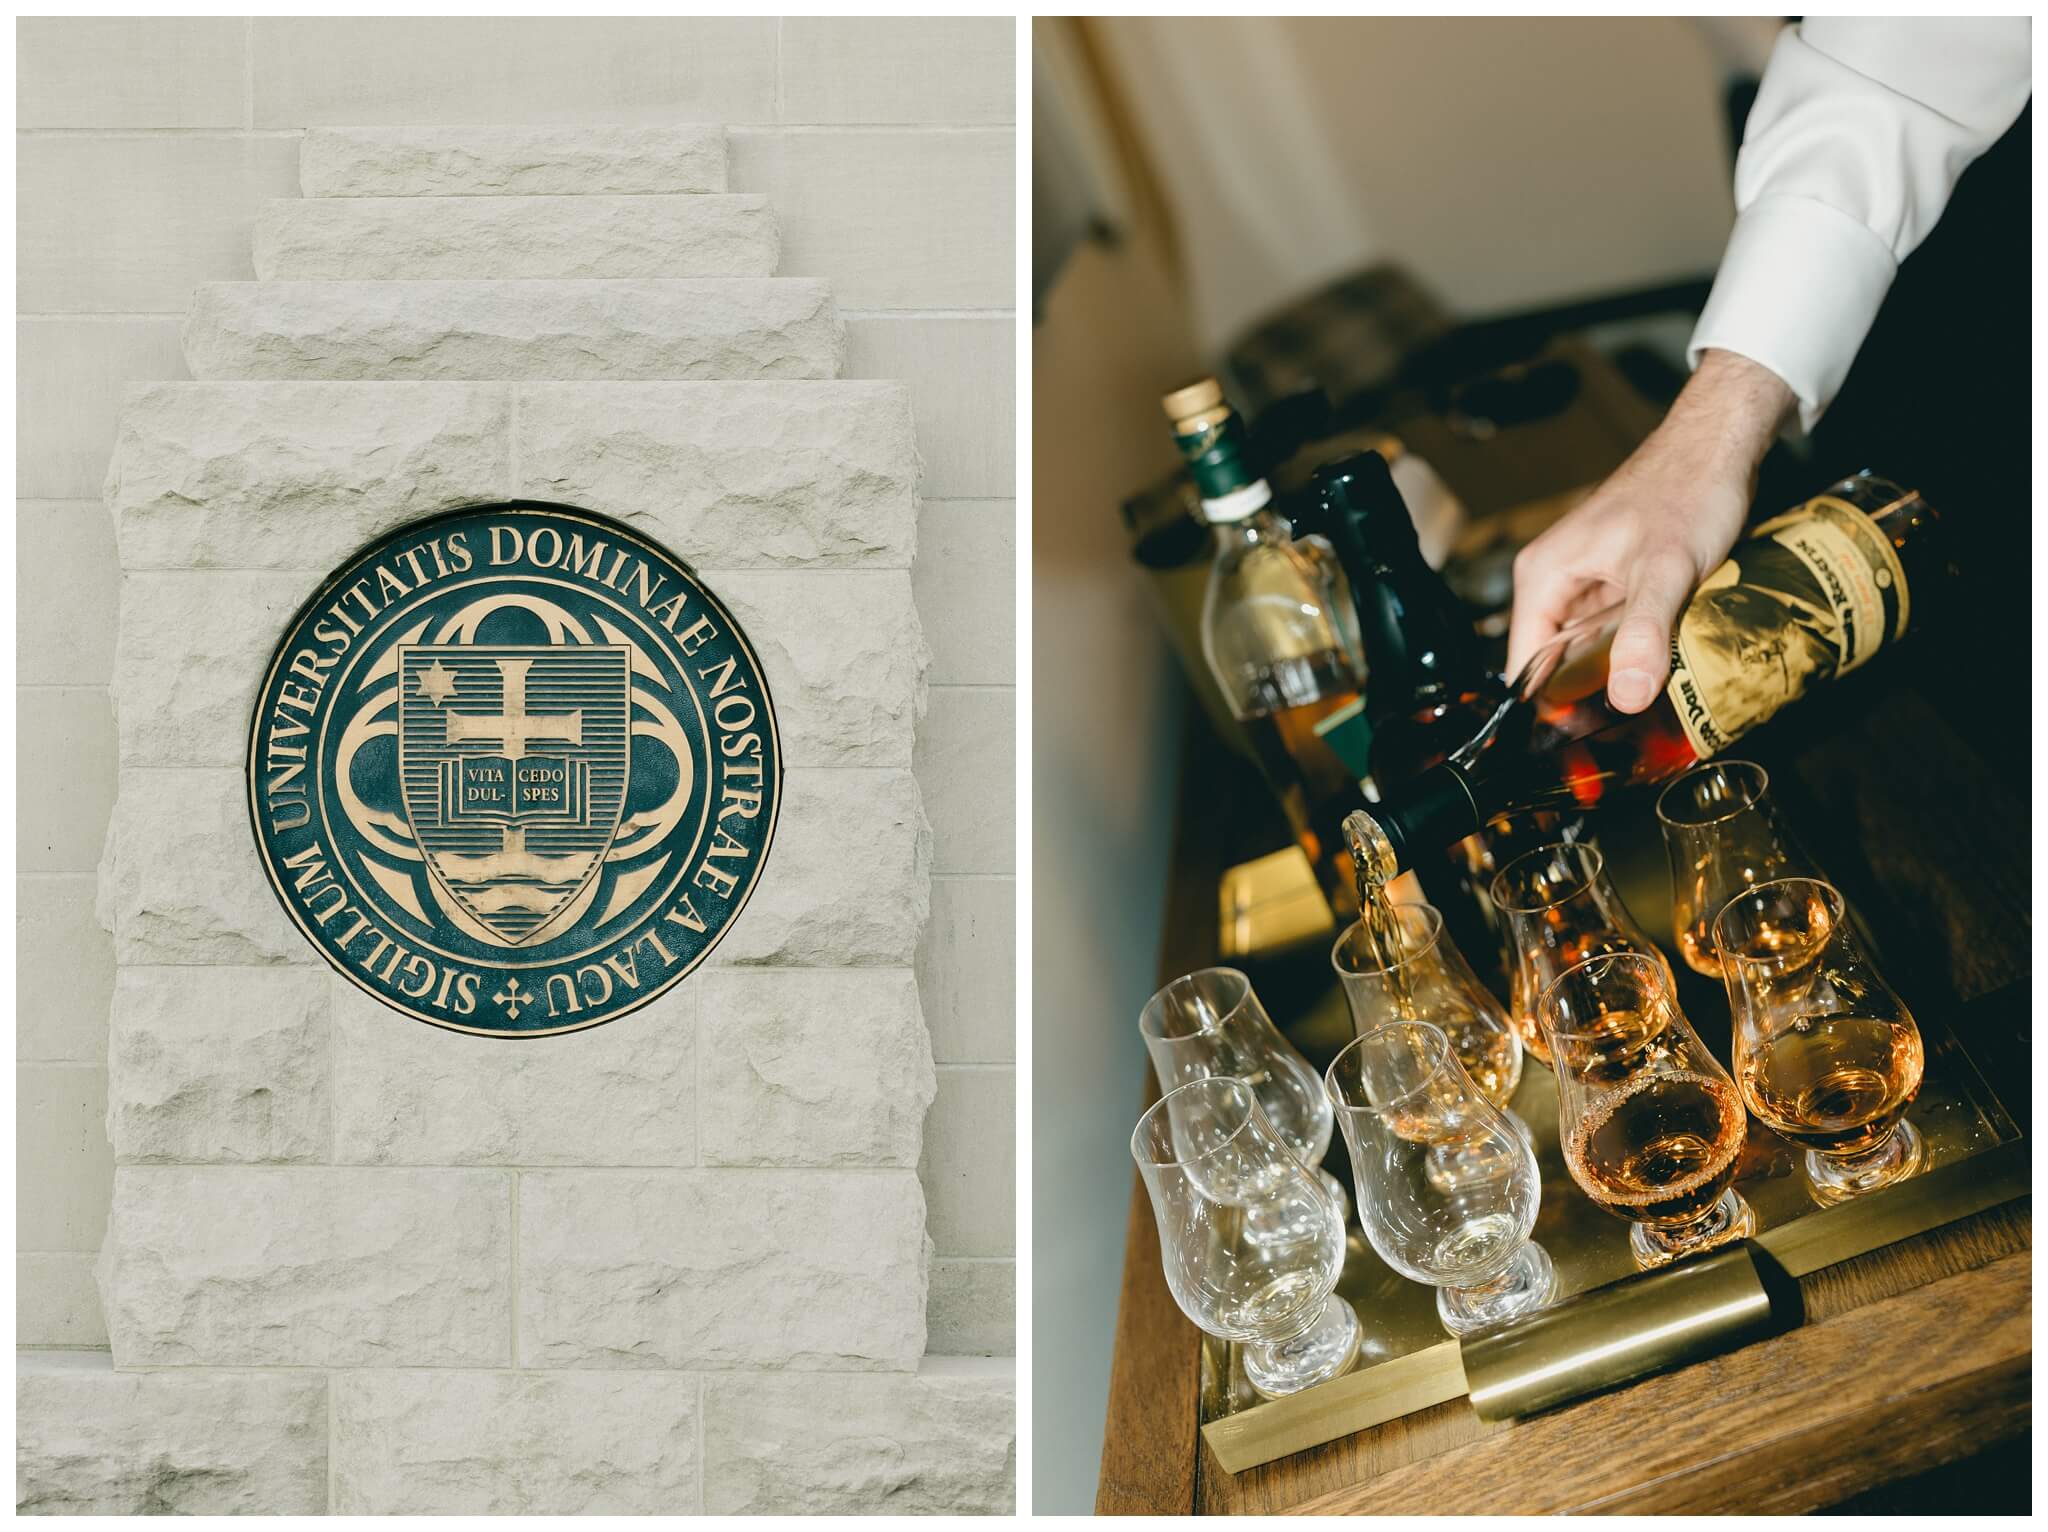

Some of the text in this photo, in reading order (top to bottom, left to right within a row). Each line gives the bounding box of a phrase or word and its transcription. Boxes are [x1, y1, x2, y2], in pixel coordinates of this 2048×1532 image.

[265, 525, 763, 1018] SIGILLUM UNIVERSITATIS DOMINAE NOSTRAE A LACU
[468, 768, 505, 783] VITA
[518, 768, 564, 783] CEDO
[467, 787, 506, 801] DUL-
[523, 787, 560, 802] SPES
